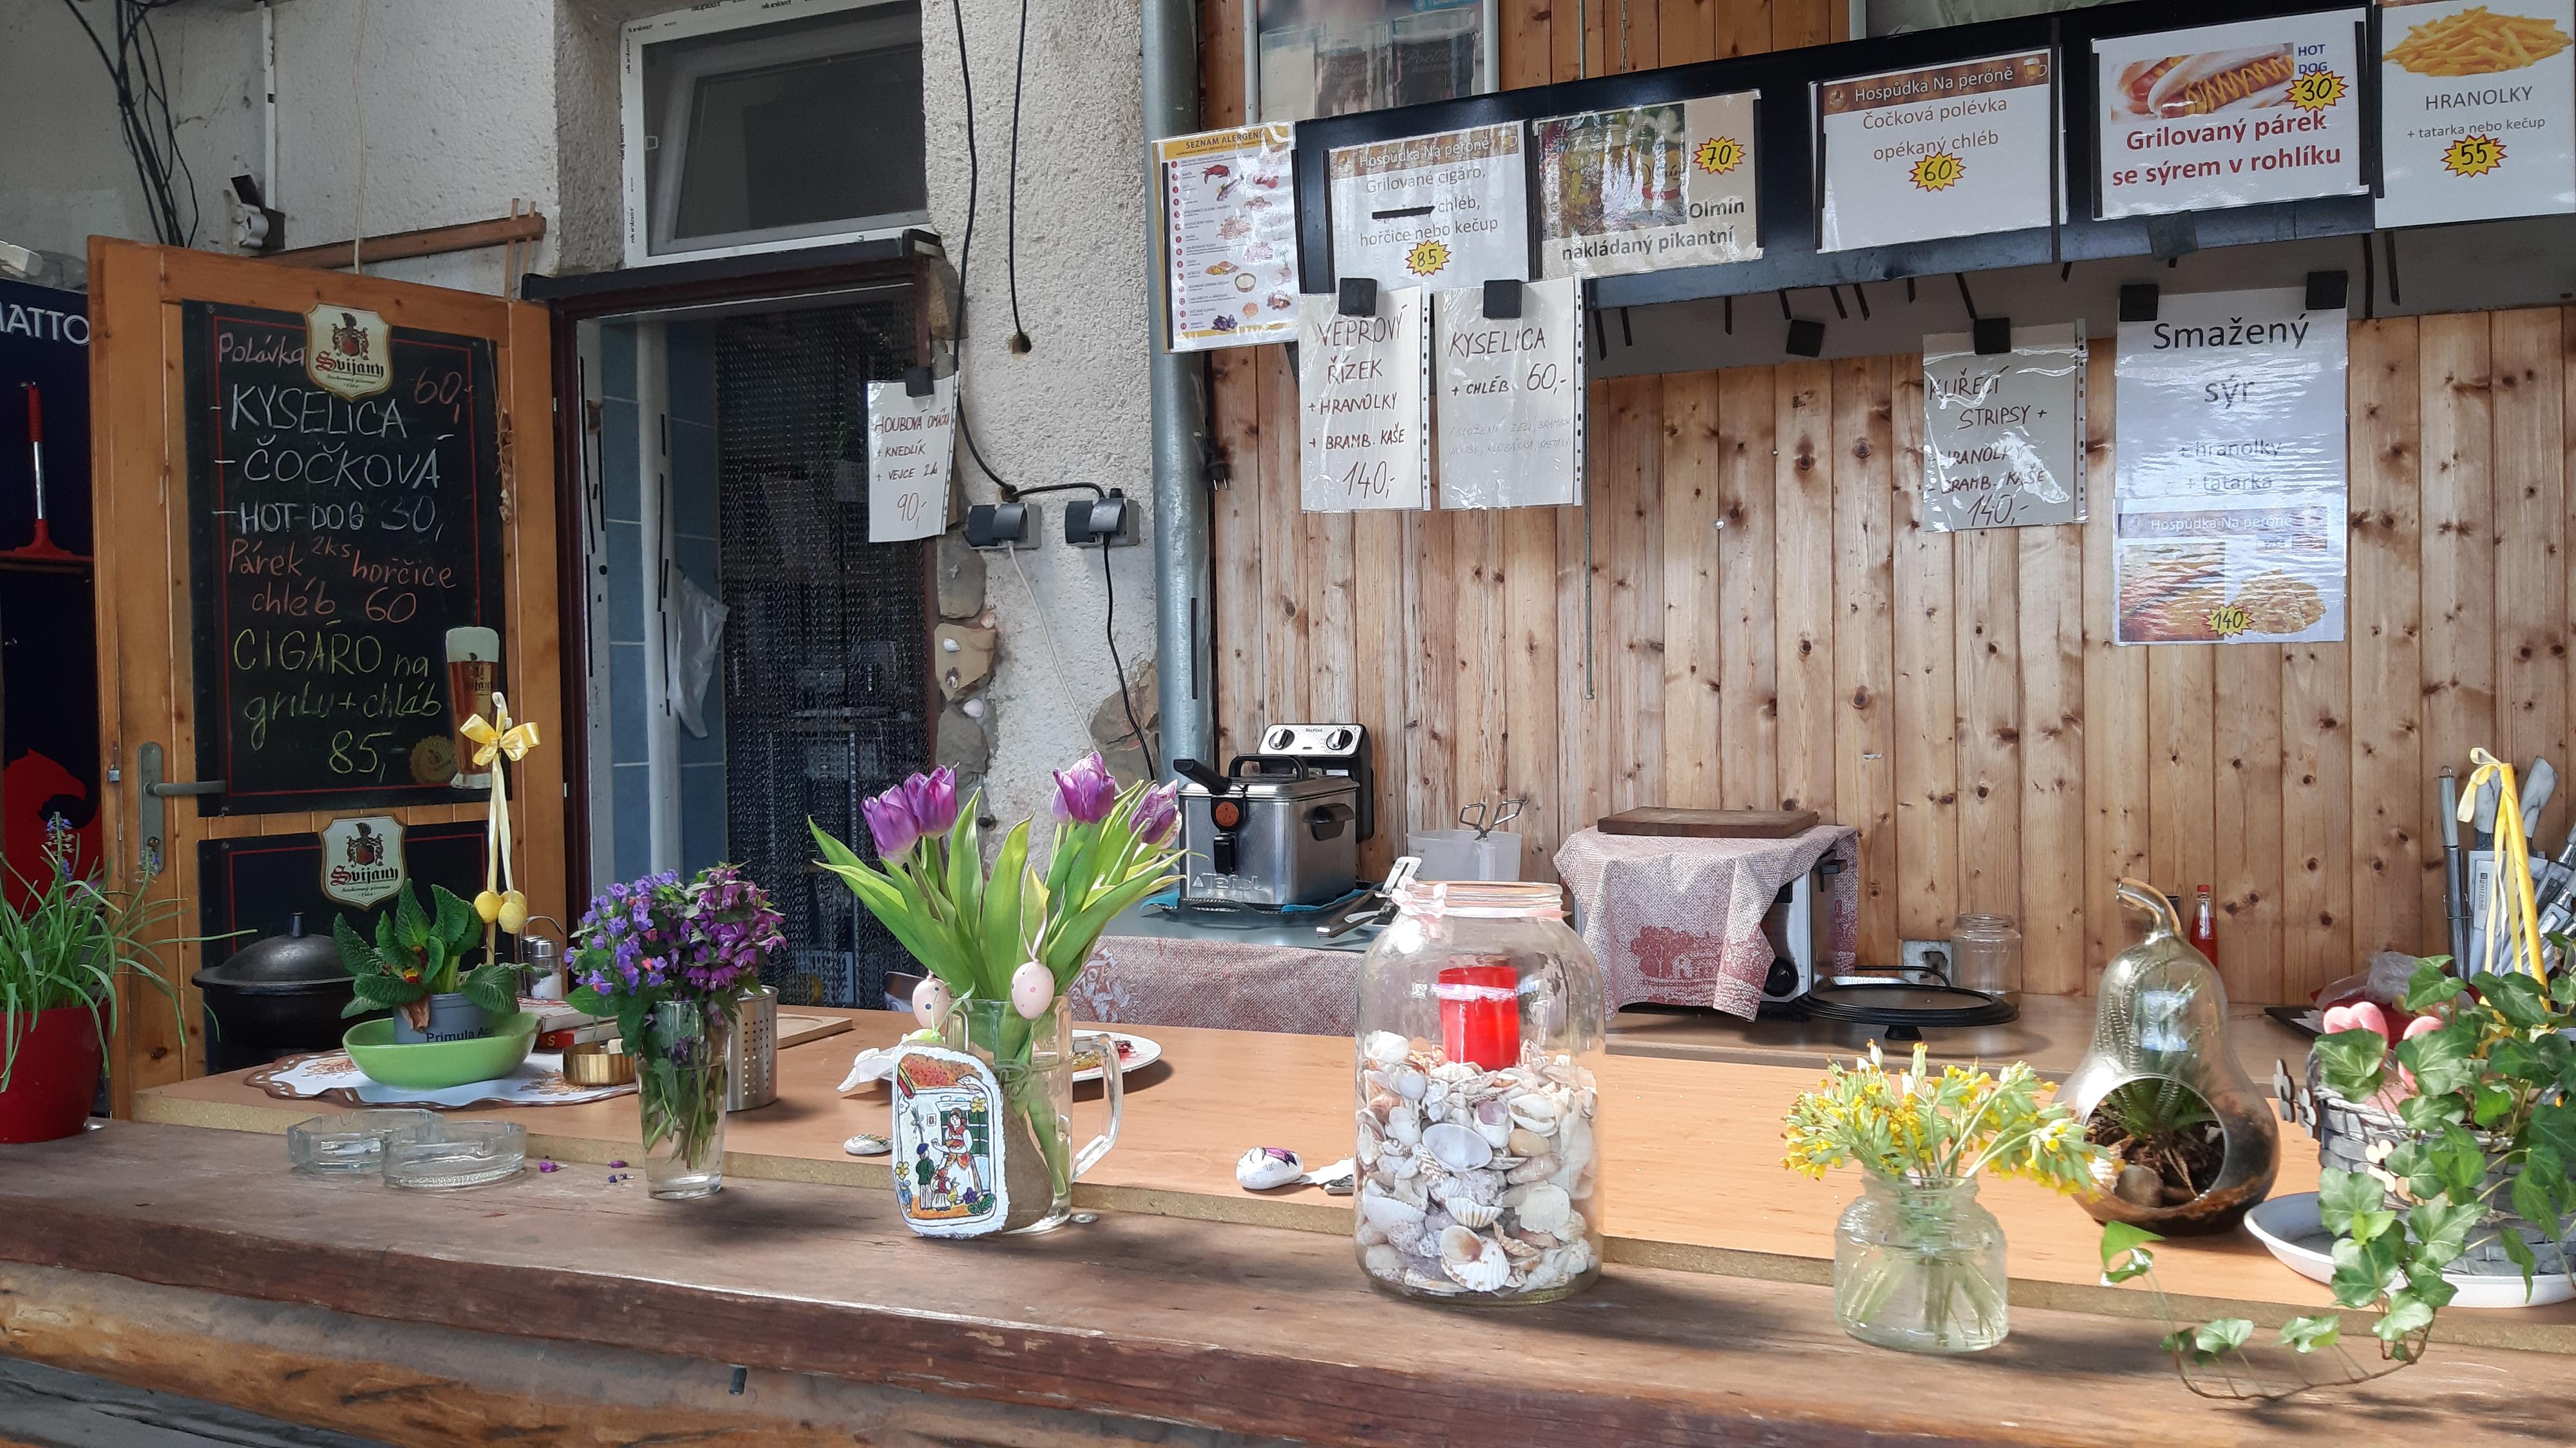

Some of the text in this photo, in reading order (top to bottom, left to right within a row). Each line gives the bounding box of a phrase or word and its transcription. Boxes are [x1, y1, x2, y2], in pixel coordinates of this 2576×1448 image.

[2298, 44, 2326, 57] HOT
[2298, 61, 2328, 75] DOG
[1854, 66, 2014, 102] Hospůdka Na peróně
[2300, 78, 2332, 102] 30
[2425, 86, 2533, 110] HRANOLKY
[1862, 97, 2007, 129] Čočková polévka
[2126, 110, 2327, 151] Grilovaný párek
[2418, 124, 2465, 138] tatarka
[2470, 120, 2502, 133] nebo
[2506, 117, 2546, 130] kečup
[1186, 137, 1219, 149] SEZNAM
[1705, 144, 1732, 166] 70
[1873, 129, 1999, 162] opékaný chléb
[2461, 140, 2492, 166] 55
[1359, 148, 1421, 168] Hospůdka
[1423, 144, 1441, 158] Na
[2112, 144, 2341, 186] se sýrem v rohlíku
[1366, 165, 1486, 194] Grilované cigáro,
[1924, 159, 1953, 182] 60
[1438, 194, 1481, 213] chléb,
[1689, 200, 1745, 219] Olmín
[1360, 218, 1499, 247] hořčice nebo kečup
[1562, 225, 1734, 262] nakládaný pikantní
[1417, 248, 1437, 268] 85
[1448, 327, 1546, 358] KYSELICA
[2153, 313, 2309, 350] Smažený
[316, 350, 384, 378] Svijany
[1466, 375, 1510, 395] CHLÉB
[2204, 374, 2255, 410] sýr
[231, 383, 408, 439] KYSELICA
[1320, 391, 1398, 416] HRANOLKY
[1957, 405, 2031, 430] STRIPSY
[1380, 421, 1405, 446] KAŠE
[885, 438, 927, 458] KNEDLÍK
[2195, 439, 2282, 458] hranolky
[243, 433, 455, 491] ČOČKOVÁ
[888, 468, 916, 481] VEJCE
[2202, 473, 2273, 491] tatarka
[2221, 516, 2239, 529] Na
[228, 538, 306, 575] Párek
[352, 550, 458, 589] hořčice
[252, 576, 418, 624] chléb 60
[2212, 611, 2245, 629] 140
[233, 620, 430, 678] CIGÁRO na
[330, 864, 399, 886] Svijany
[426, 1029, 475, 1043] Primula
